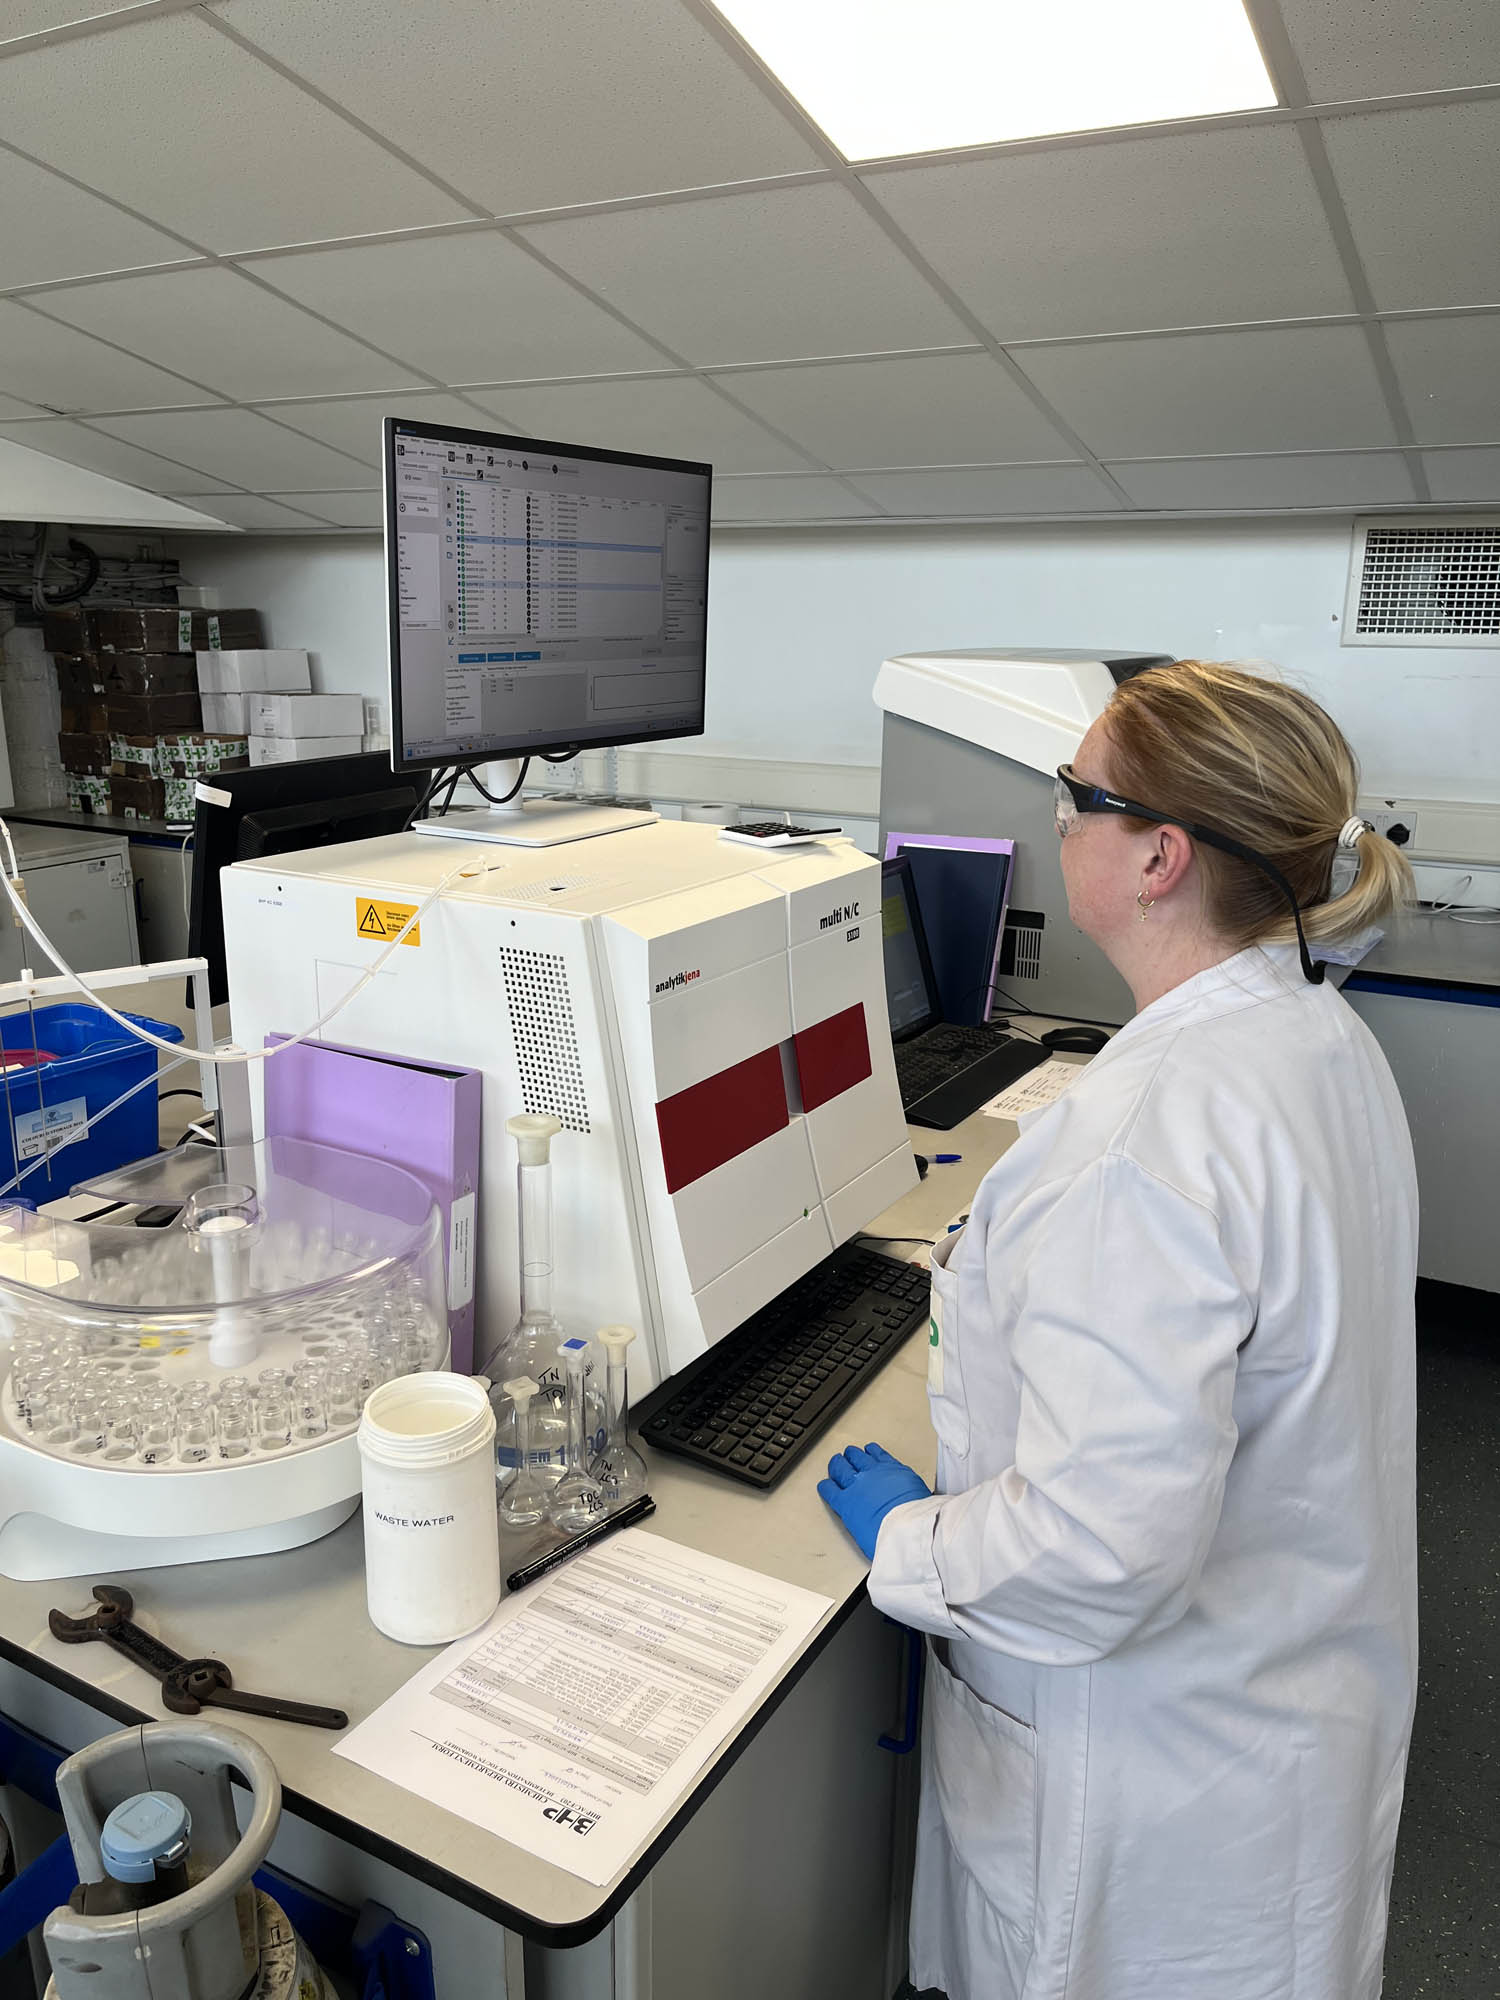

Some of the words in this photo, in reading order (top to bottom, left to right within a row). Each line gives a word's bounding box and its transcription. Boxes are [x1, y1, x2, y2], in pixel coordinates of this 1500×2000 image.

[819, 906, 842, 930] multi
[843, 901, 860, 922] N/C
[655, 968, 701, 993] analytikjena
[538, 1367, 560, 1385] TN
[600, 1459, 613, 1471] TN
[578, 1491, 599, 1505] TOC
[588, 1501, 604, 1515] LCS
[375, 1511, 409, 1527] WASTE
[411, 1514, 455, 1527] WATER
[431, 1743, 453, 1757] FORM
[443, 1740, 477, 1759] WORKSHEET
[453, 1754, 503, 1781] DEPARTMENT
[478, 1757, 497, 1769] TOC/TN
[503, 1779, 548, 1803] CHEMISTRY
[506, 1771, 554, 1796] DETERMINATION
[543, 1807, 596, 1837] BHP
